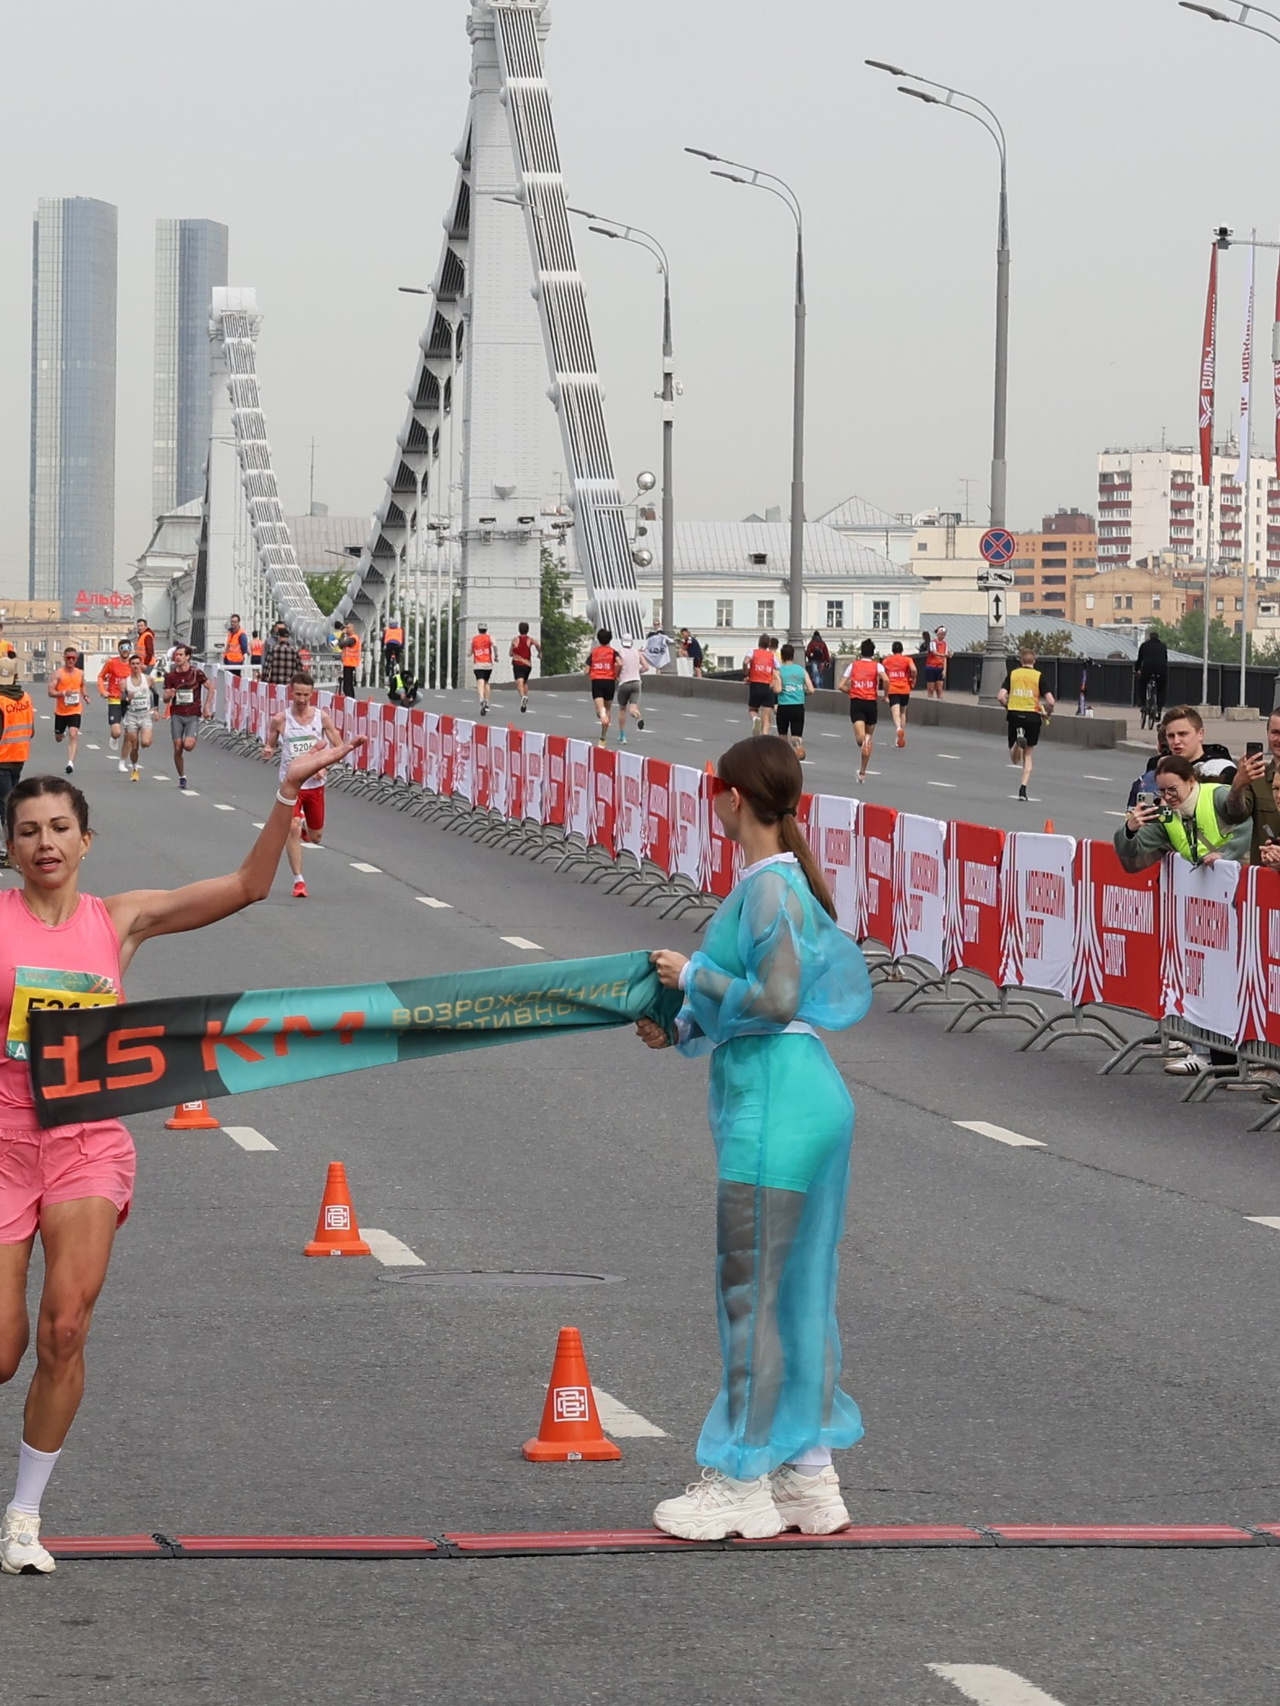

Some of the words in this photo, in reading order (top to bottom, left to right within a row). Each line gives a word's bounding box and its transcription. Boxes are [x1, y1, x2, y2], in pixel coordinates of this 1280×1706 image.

[392, 979, 629, 1026] ВОЗРОЖДЕНИЕ
[41, 1026, 166, 1100] 15
[201, 1011, 366, 1073] КМ
